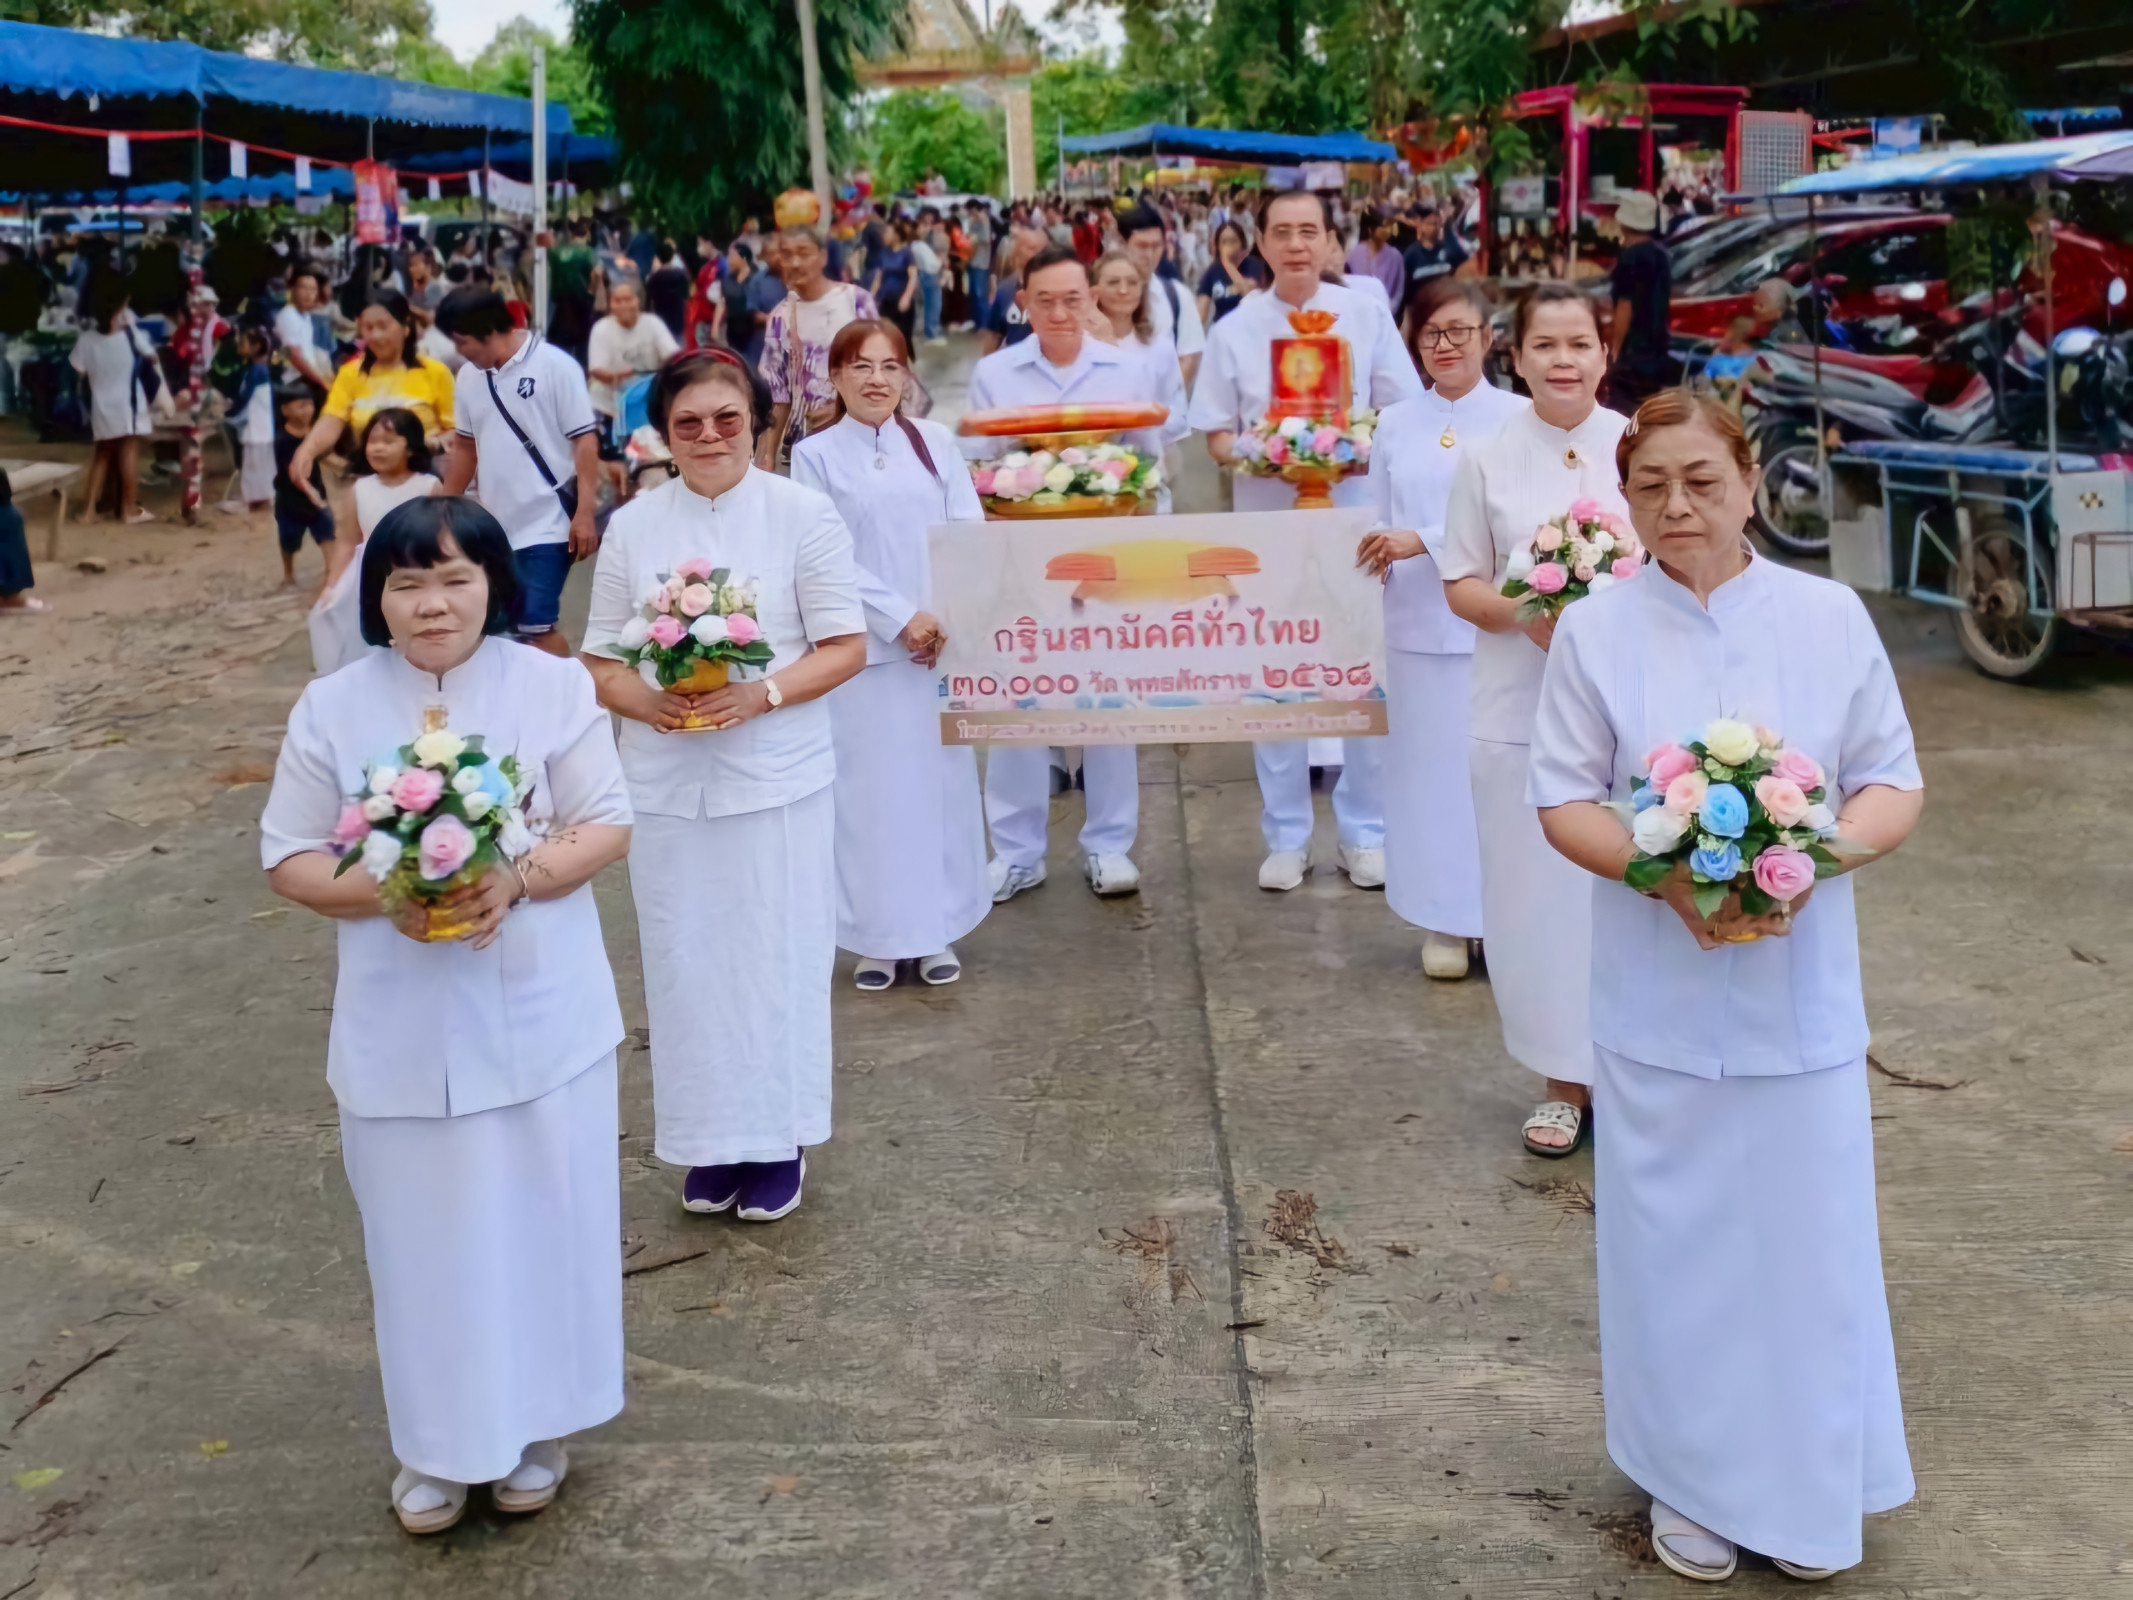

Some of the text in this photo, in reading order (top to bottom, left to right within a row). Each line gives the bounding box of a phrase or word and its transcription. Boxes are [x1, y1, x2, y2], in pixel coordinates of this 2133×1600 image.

[994, 598, 1321, 663] กฐินสามัคคีทั่วไทย
[952, 674, 1080, 700] ๓๐,๐๐๐
[1262, 662, 1373, 689] ๒๕๖๘
